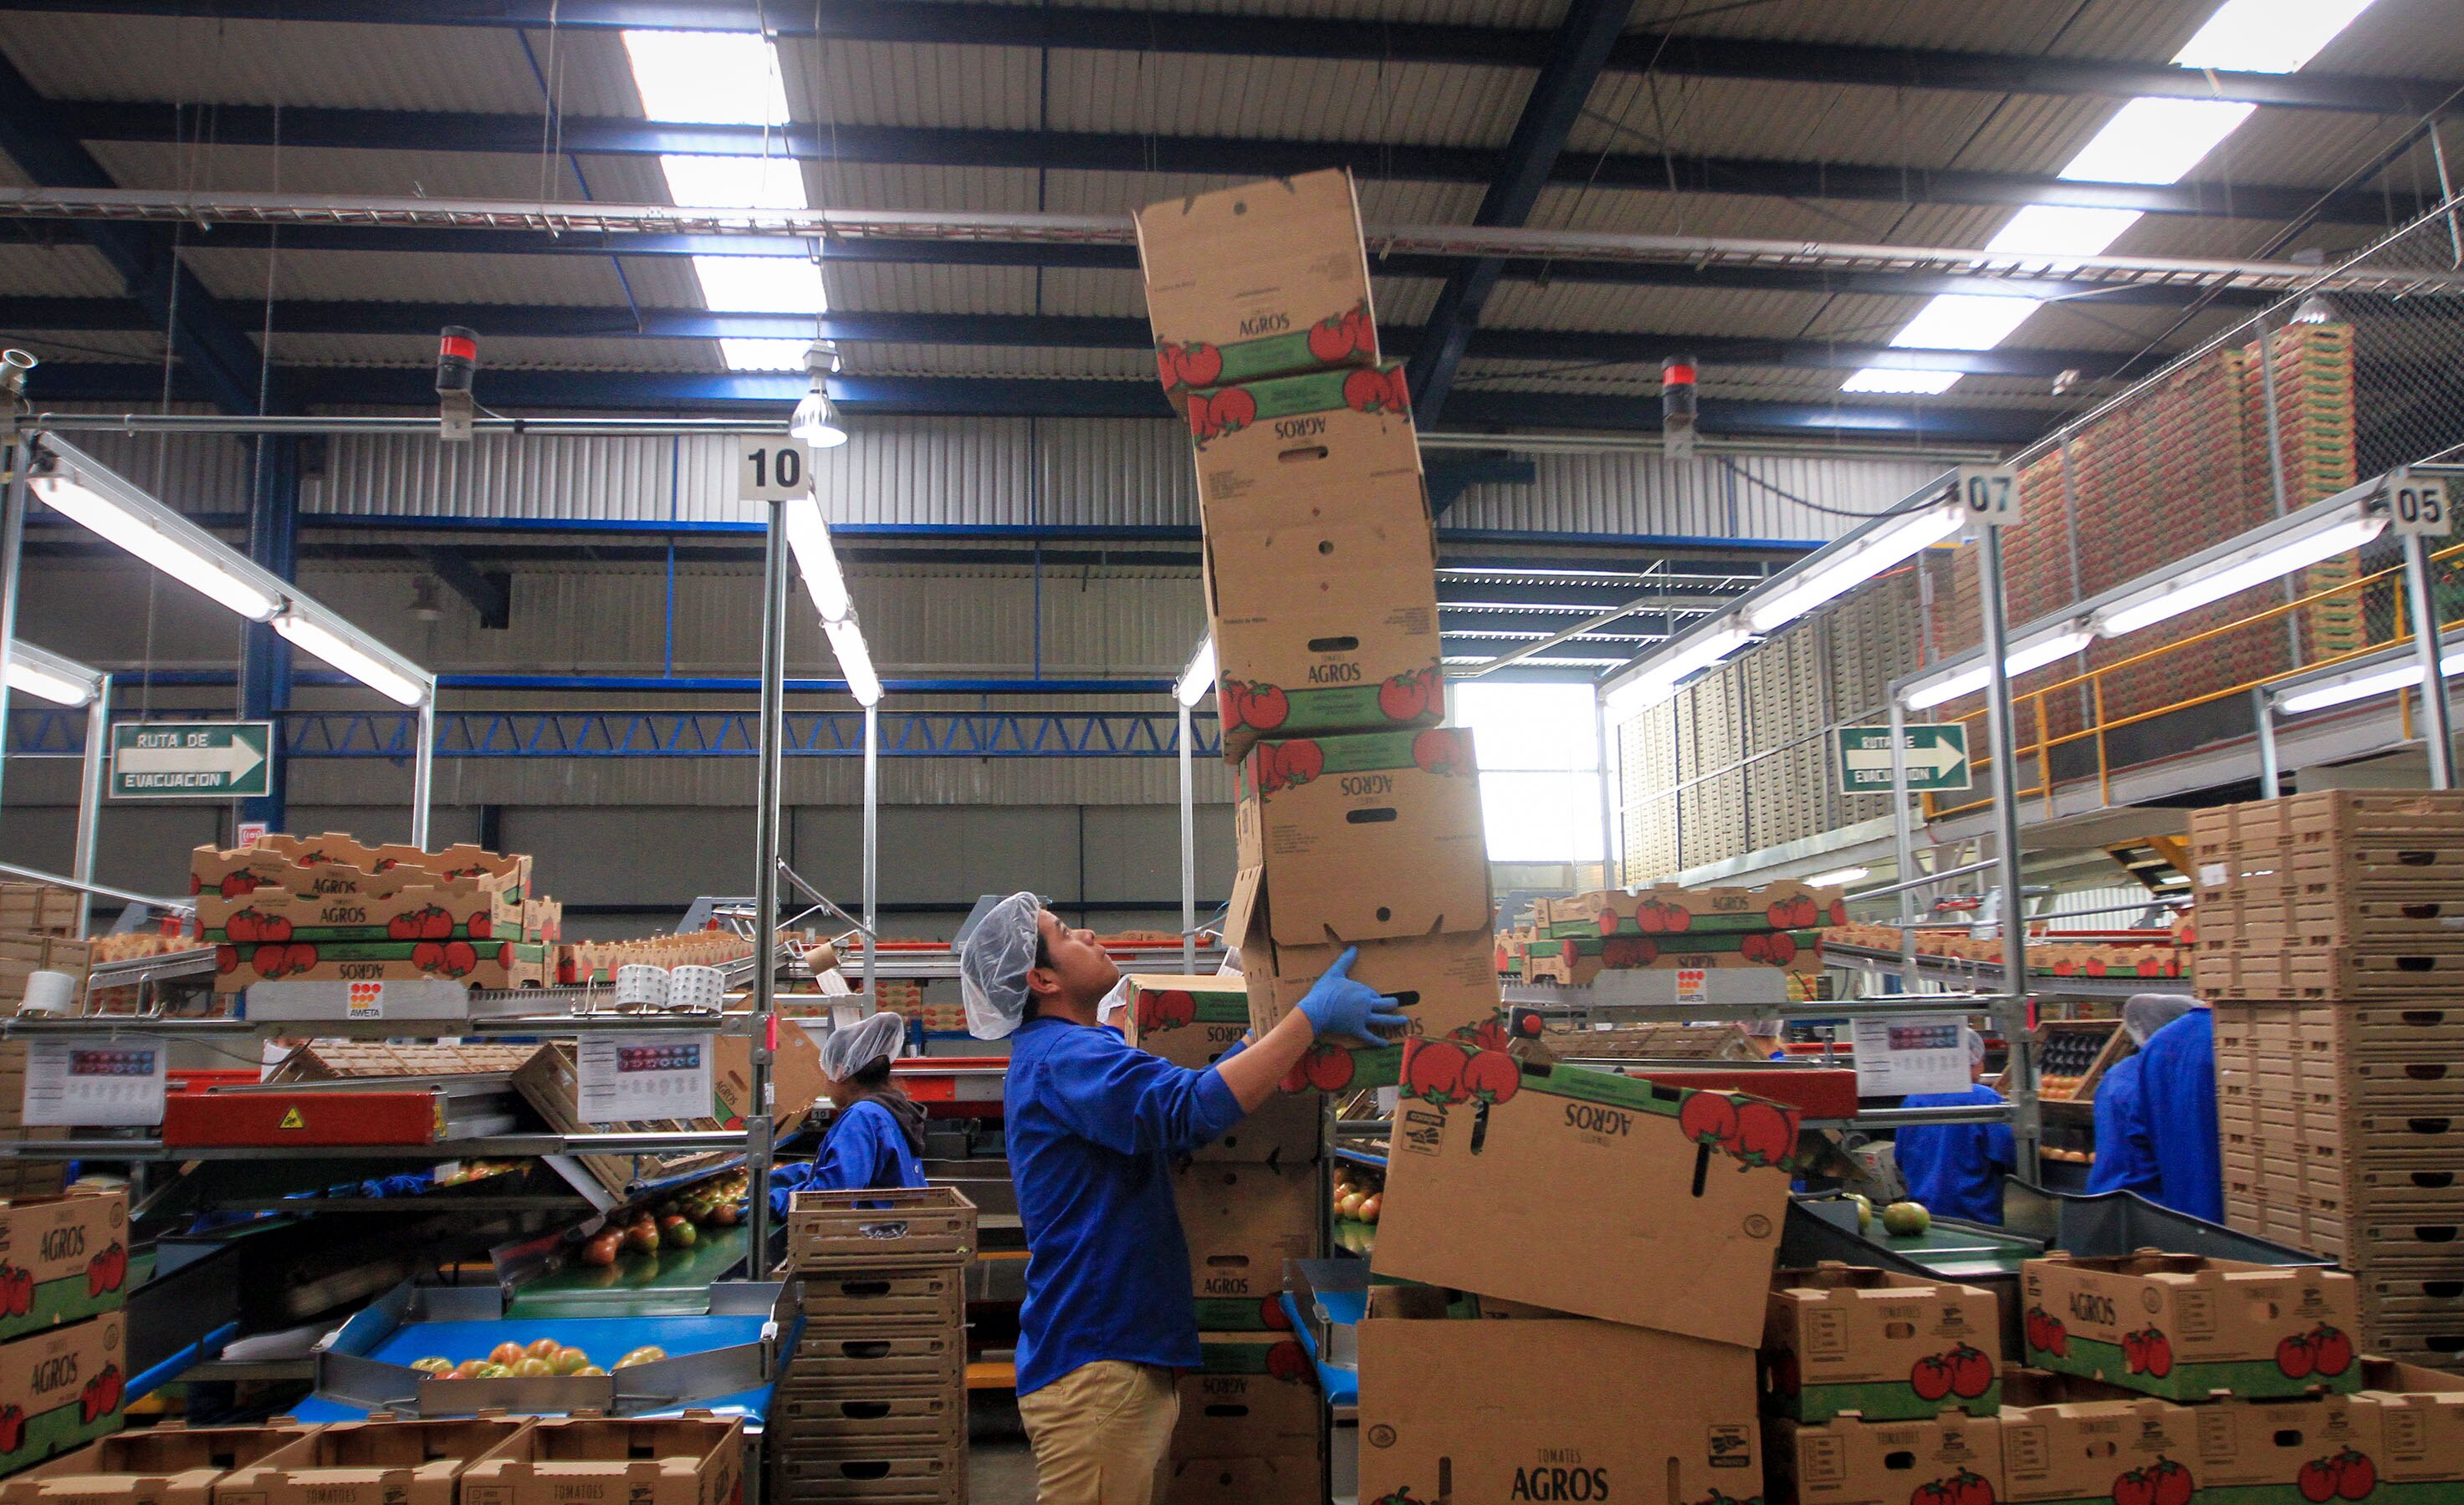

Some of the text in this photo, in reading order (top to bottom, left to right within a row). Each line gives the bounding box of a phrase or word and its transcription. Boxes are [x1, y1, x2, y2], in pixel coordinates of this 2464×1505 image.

[1240, 314, 1290, 337] AGROS
[1275, 417, 1326, 440] AGROS
[748, 448, 800, 487] 10
[1969, 475, 2012, 512] 07
[2398, 488, 2441, 523] 05
[1308, 662, 1361, 683] AGROS
[137, 734, 208, 748] RUTA DE
[125, 773, 220, 788] EVACUACION
[1341, 775, 1393, 797] AGROS
[313, 879, 357, 893] AGROS
[1712, 896, 1750, 911] AGROS
[321, 907, 366, 923] AGROS
[340, 963, 385, 980] AGROS
[350, 1008, 380, 1018] AWETA
[715, 1080, 739, 1105] AGROS
[1565, 1104, 1633, 1136] AGROS
[38, 1225, 85, 1264] AGROS
[1204, 1278, 1249, 1294] AGROS
[2069, 1293, 2116, 1326] AGROS
[30, 1352, 79, 1395] AGROS
[1204, 1377, 1248, 1395] AGROS
[1538, 1448, 1582, 1463] TOMATES
[554, 1485, 604, 1499] TOMATOES
[1511, 1467, 1609, 1502] AGROS
[306, 1489, 356, 1503] TOMATOES
